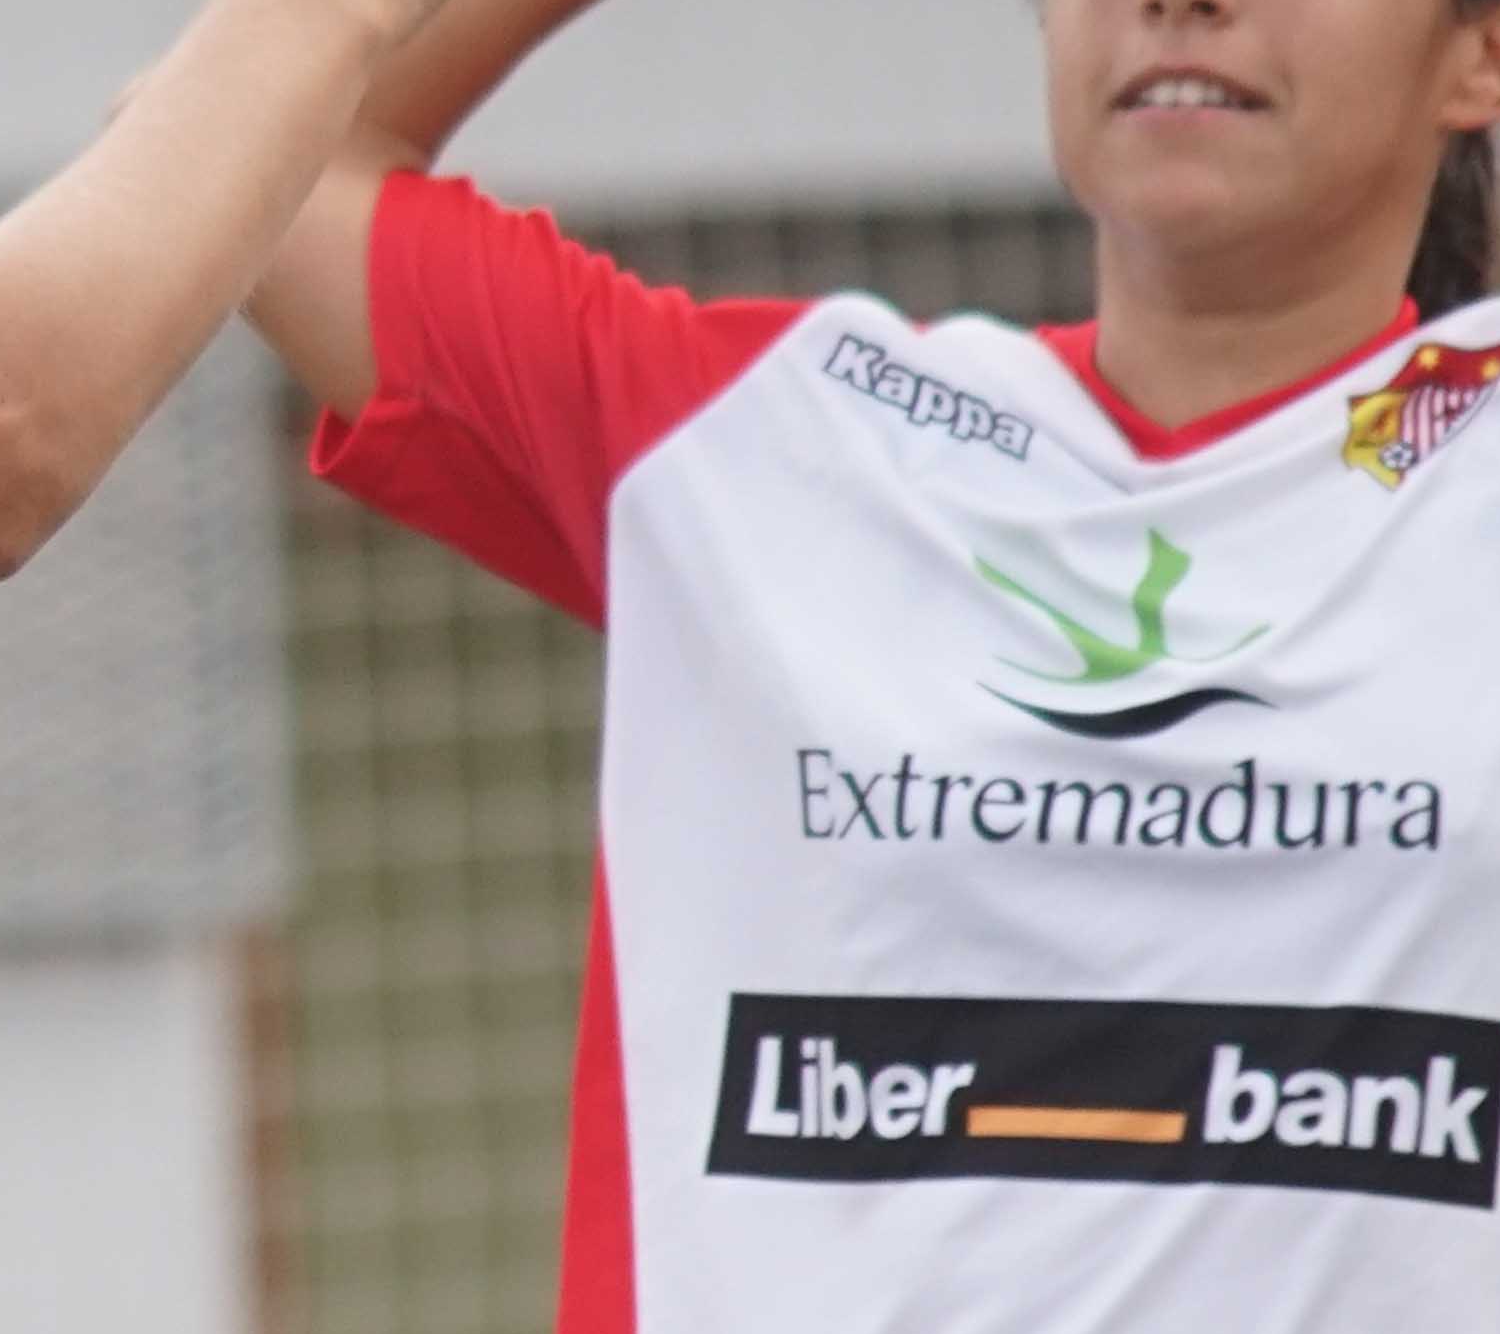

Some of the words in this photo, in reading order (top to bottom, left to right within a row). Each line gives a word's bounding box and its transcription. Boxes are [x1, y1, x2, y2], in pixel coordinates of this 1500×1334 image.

[823, 334, 1033, 461] Kappa
[797, 748, 1441, 851] Extremadura
[745, 1034, 978, 1142] Liber
[1201, 1045, 1488, 1164] bank
